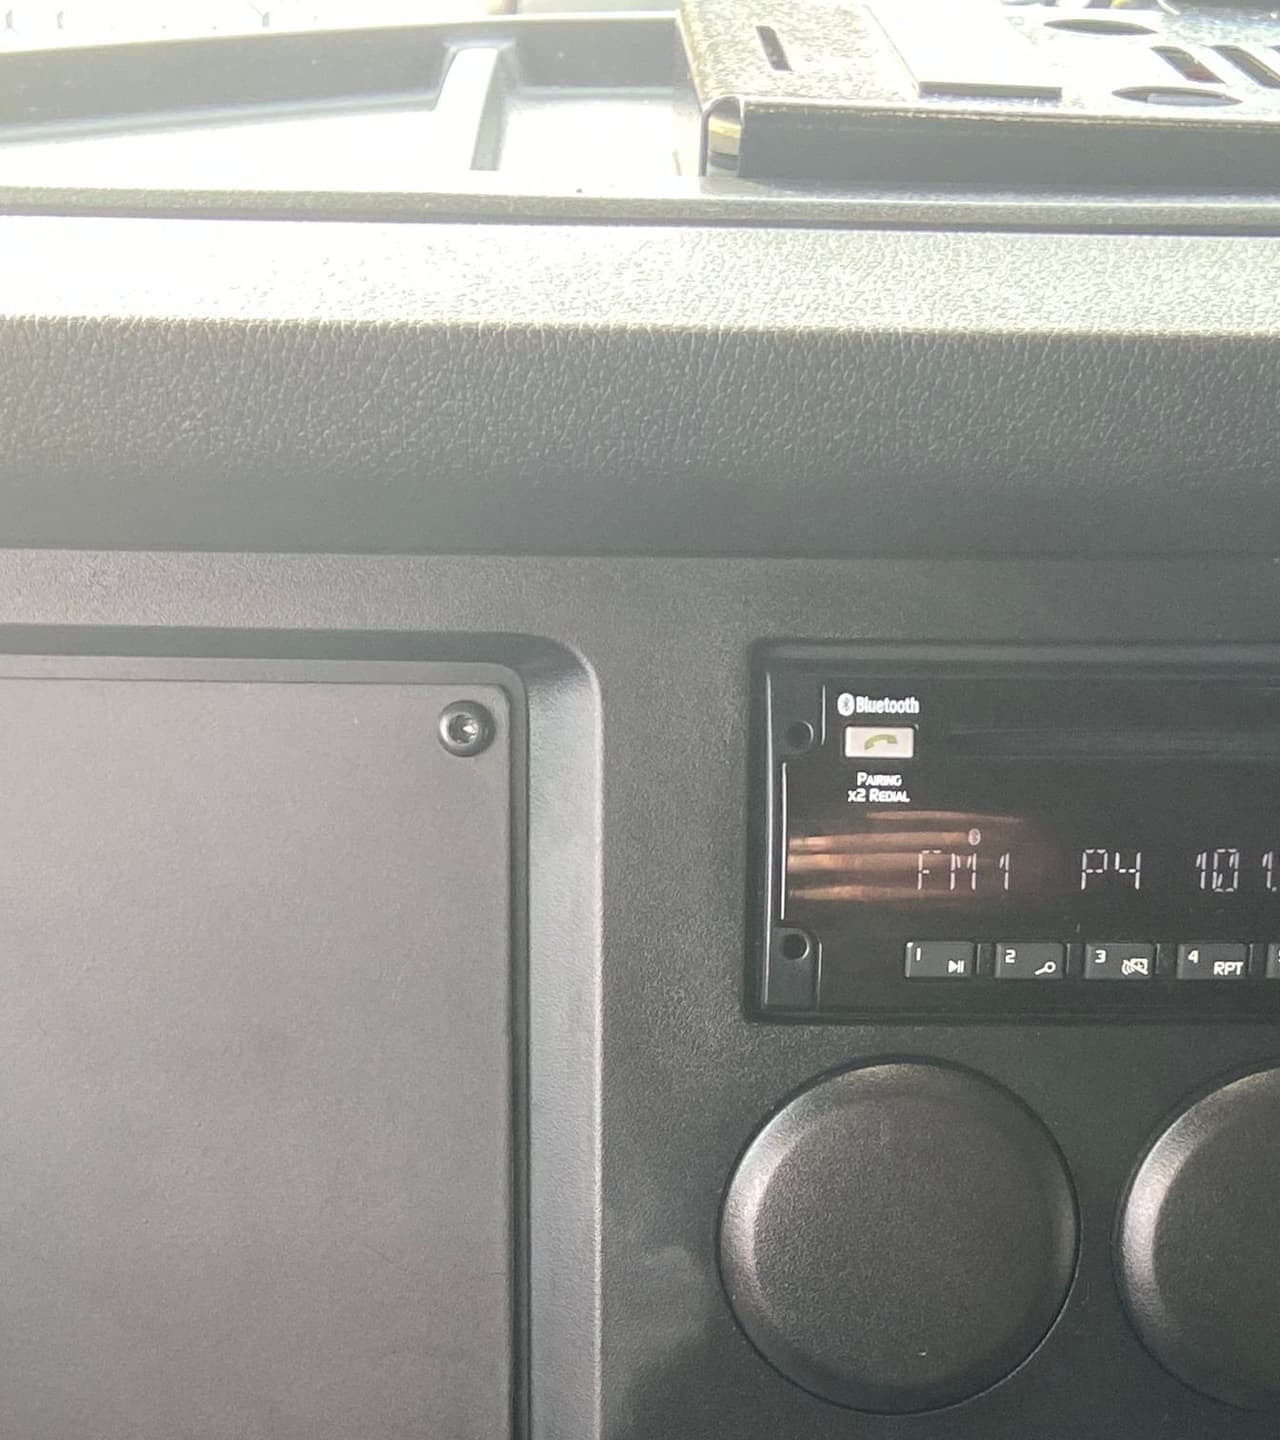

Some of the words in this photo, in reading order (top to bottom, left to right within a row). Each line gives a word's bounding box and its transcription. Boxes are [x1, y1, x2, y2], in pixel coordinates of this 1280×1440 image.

[855, 696, 919, 715] Bluetooth
[1080, 848, 1142, 891] P4
[1005, 949, 1016, 964] 2
[1095, 949, 1107, 964] 3
[1187, 949, 1200, 964] 4
[1213, 961, 1244, 977] RPT
